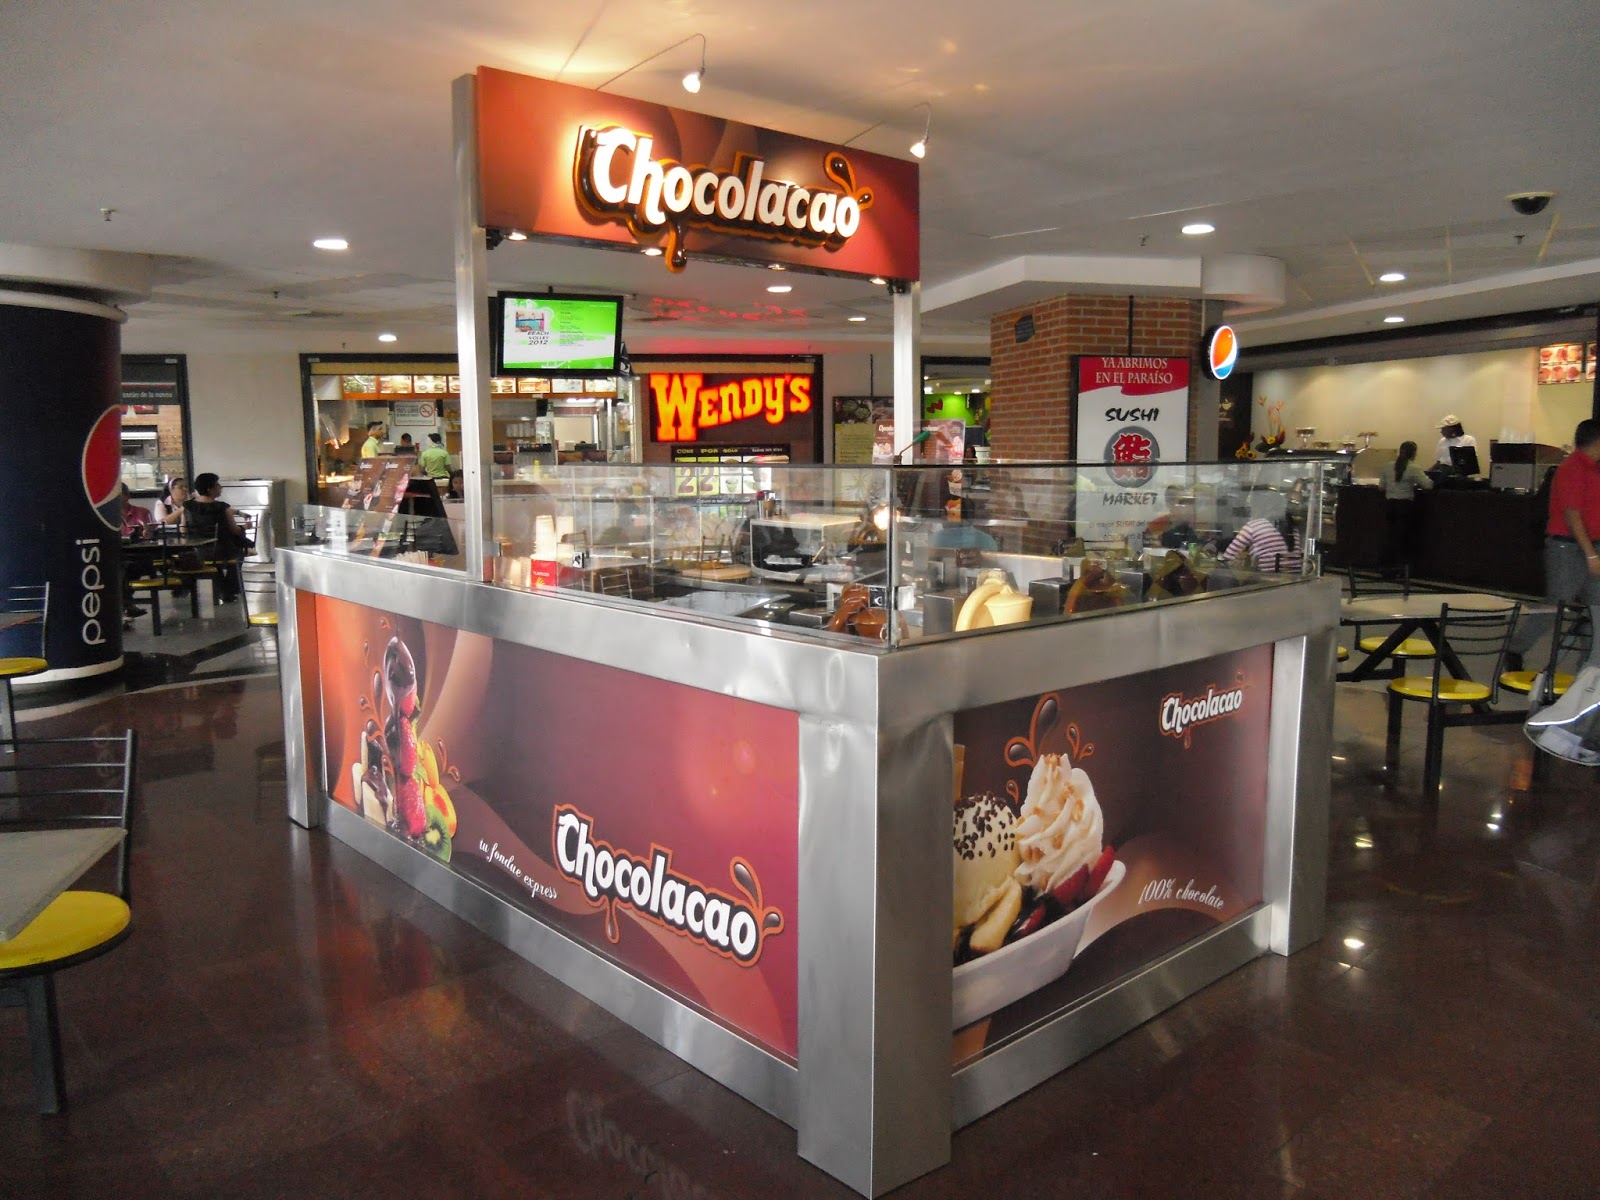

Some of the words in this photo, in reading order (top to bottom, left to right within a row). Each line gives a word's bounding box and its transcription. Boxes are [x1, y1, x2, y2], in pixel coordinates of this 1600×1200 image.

[589, 125, 861, 239] Chocolacao
[1095, 372, 1112, 384] EN
[1113, 372, 1124, 384] EL
[1127, 370, 1174, 384] PARAÍSO
[1101, 357, 1116, 369] YA
[1117, 357, 1168, 369] ABRIMOS
[1105, 408, 1160, 421] SUSHI
[1102, 491, 1158, 506] MARKET
[75, 538, 107, 646] pepsi
[1161, 688, 1243, 734] Chocolacao
[479, 837, 490, 854] tu
[486, 842, 523, 878] fondue
[523, 873, 559, 900] express
[556, 812, 758, 956] Chocolacao
[1138, 878, 1177, 905] 100%
[1175, 879, 1225, 910] chocolate
